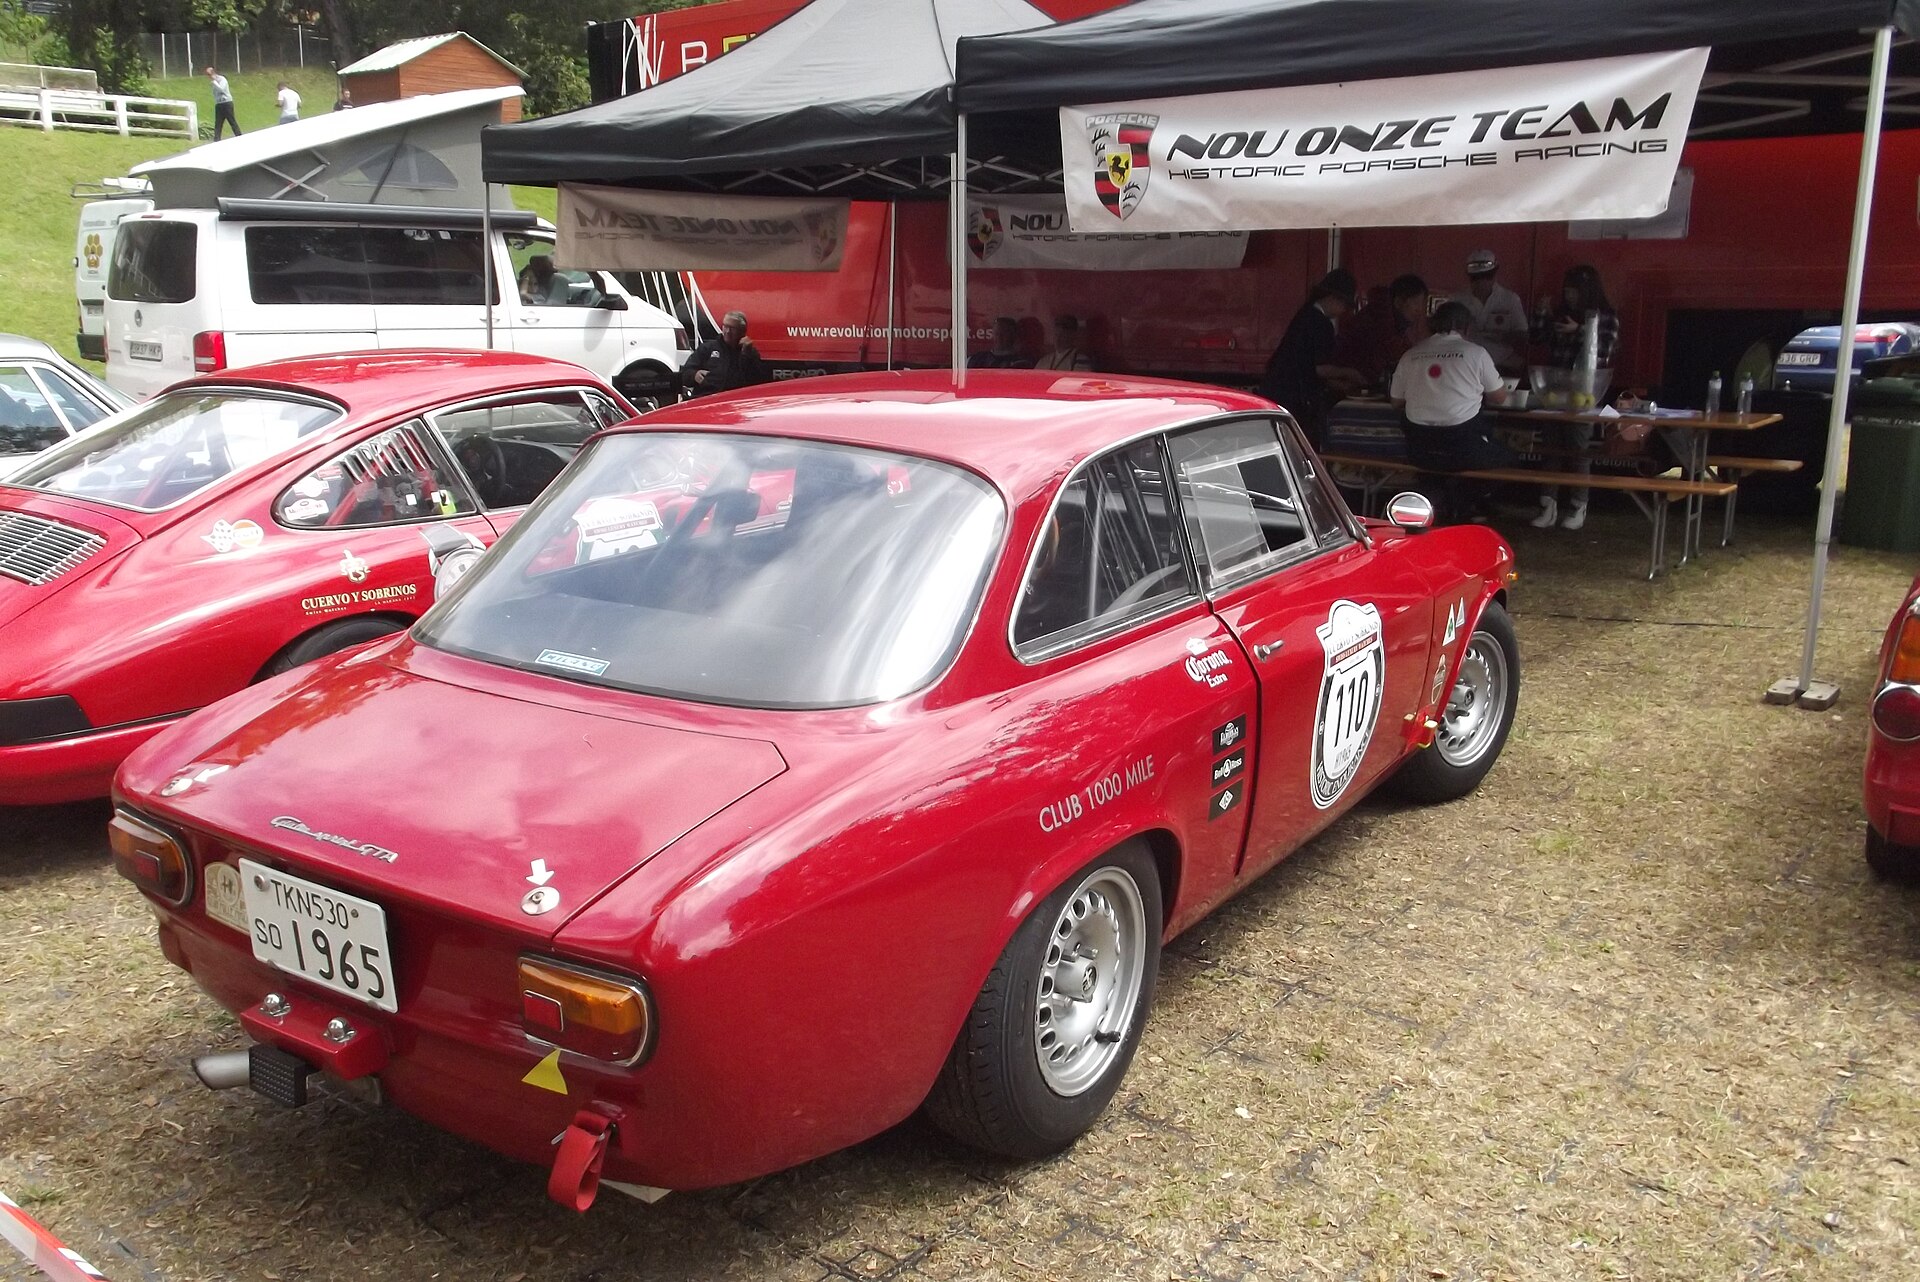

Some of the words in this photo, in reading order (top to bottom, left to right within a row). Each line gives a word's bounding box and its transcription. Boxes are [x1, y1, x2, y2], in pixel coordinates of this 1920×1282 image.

[1086, 113, 1158, 127] PORSCHE
[1166, 128, 1290, 162] NOU
[1294, 115, 1457, 157] ONZE
[1468, 92, 1673, 144] TEAM
[1168, 164, 1305, 180] HISTORIC
[1319, 152, 1497, 175] PORSCHE
[1515, 138, 1667, 162] RACING
[1010, 214, 1064, 231] NOU
[301, 593, 350, 610] CUERVO
[351, 591, 361, 603] Y
[361, 583, 417, 602] SOBRINOS
[1185, 649, 1233, 683] Corona
[1205, 673, 1229, 688] Extra
[1333, 670, 1369, 748] 110
[1039, 794, 1083, 833] CLUB
[1085, 772, 1122, 811] 1000
[1125, 754, 1155, 791] MILE
[359, 844, 399, 864] GTA
[270, 878, 350, 930] TKN530
[254, 917, 283, 950] SO
[291, 919, 385, 999] 1965
